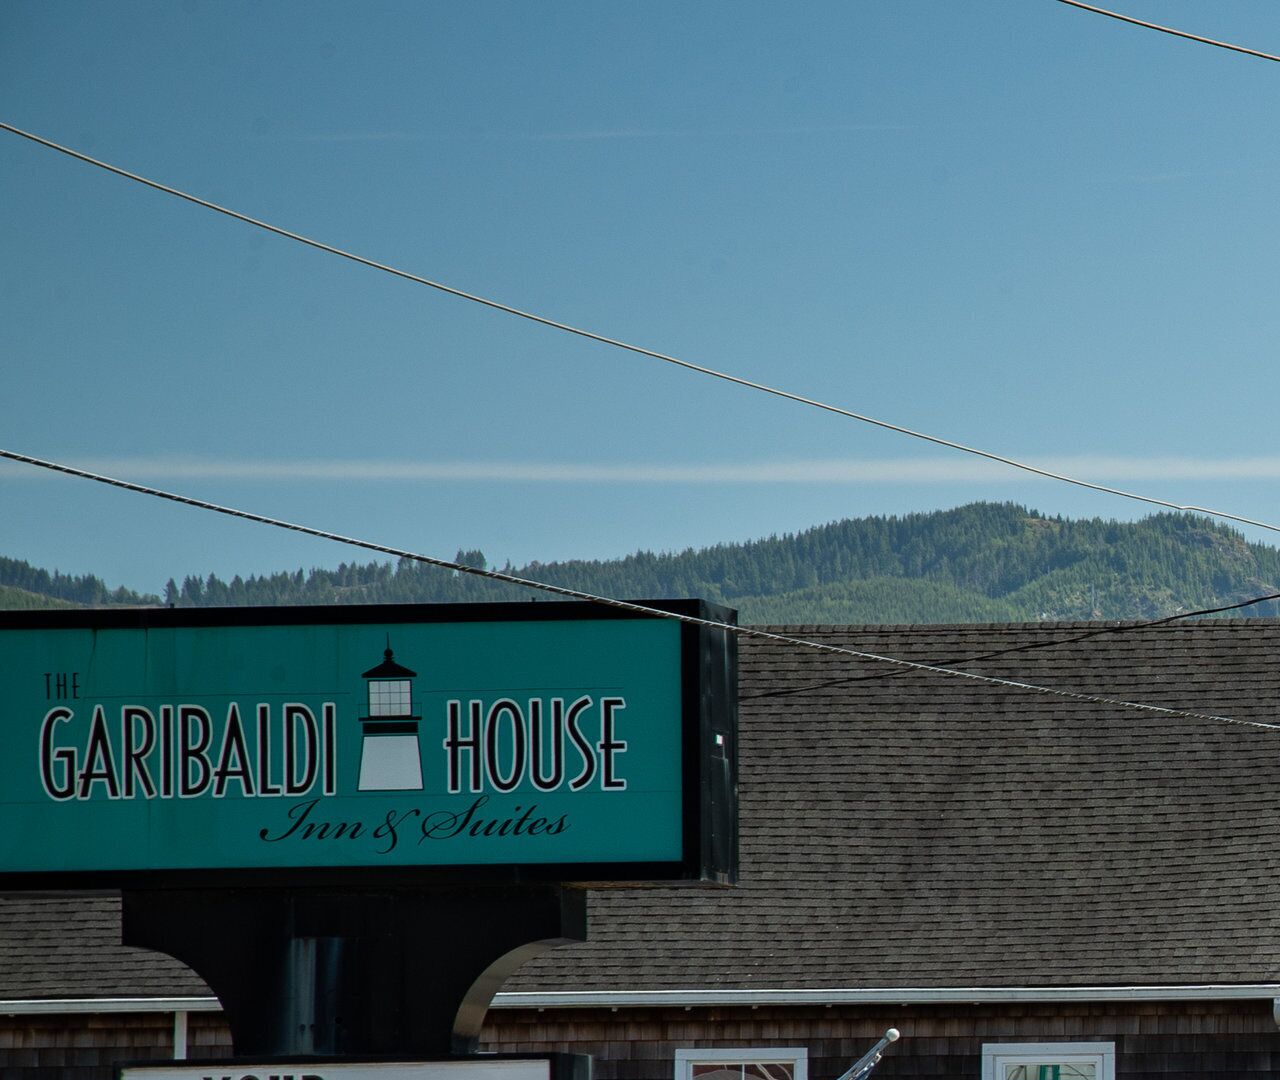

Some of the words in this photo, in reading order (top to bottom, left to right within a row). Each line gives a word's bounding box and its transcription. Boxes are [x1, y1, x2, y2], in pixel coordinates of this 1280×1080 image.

[43, 672, 80, 700] THE
[38, 700, 337, 801] GARIBALDI
[444, 695, 628, 794] HOUSE
[260, 798, 364, 842] Inn
[373, 810, 420, 854] &
[421, 796, 572, 846] Suites
